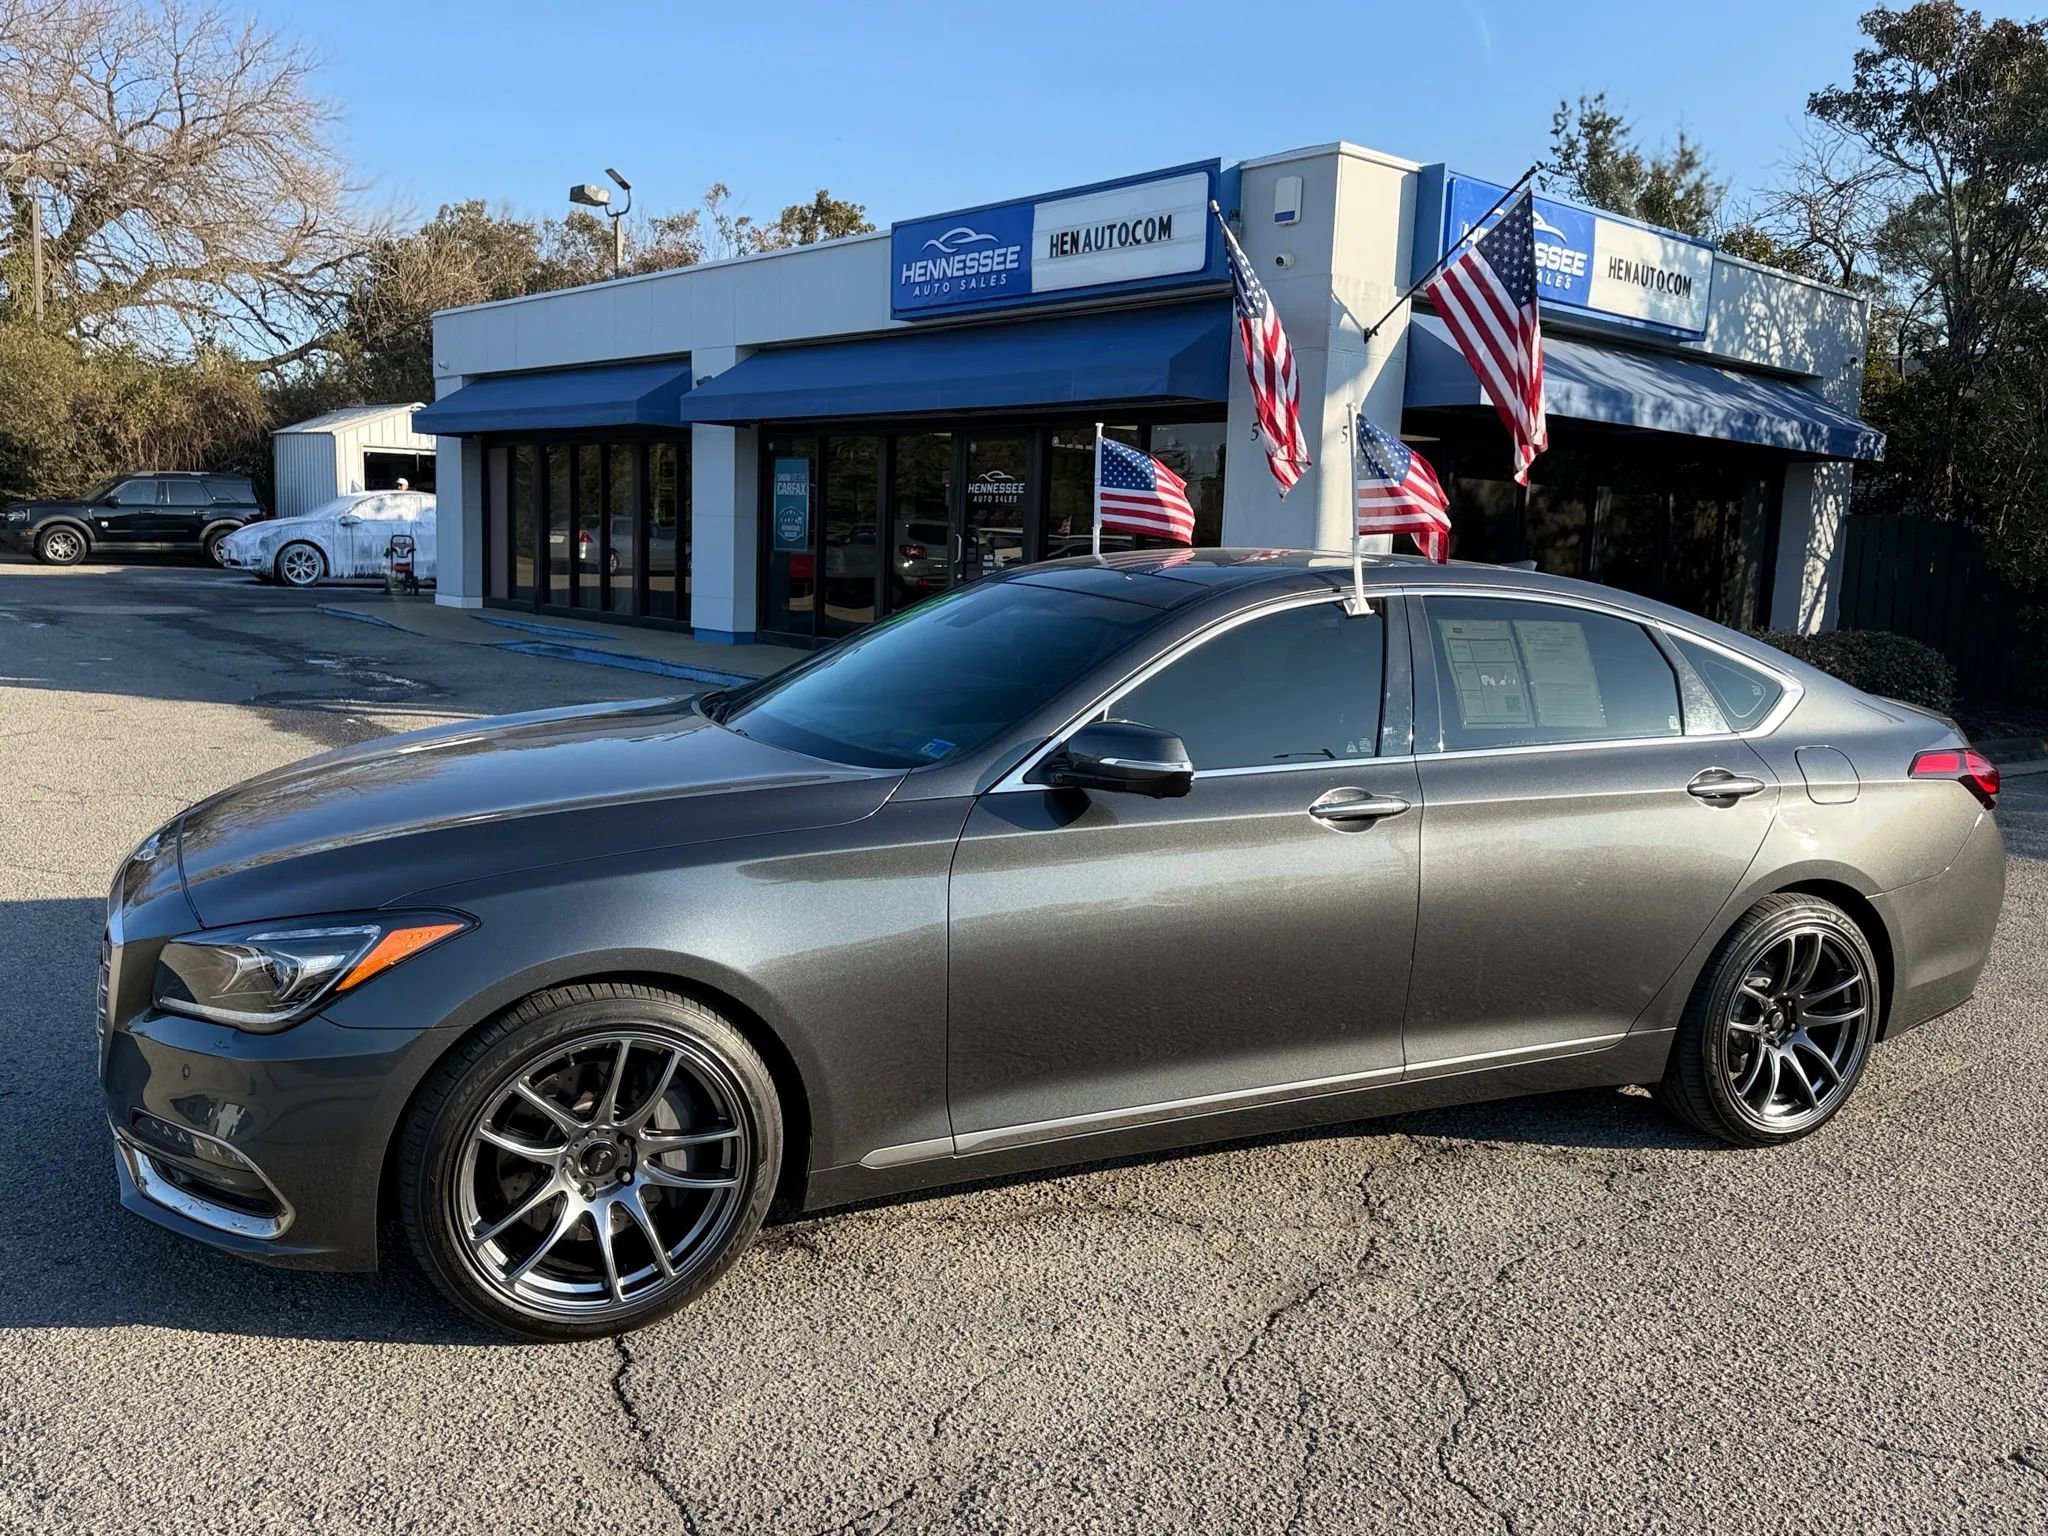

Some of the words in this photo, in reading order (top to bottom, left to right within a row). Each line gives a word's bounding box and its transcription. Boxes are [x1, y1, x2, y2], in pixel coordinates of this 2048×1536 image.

[1048, 214, 1173, 258] HENAUTO.COM
[1460, 221, 1588, 277] HSSEE
[901, 245, 1021, 285] HENNESSEE
[913, 282, 951, 297] AUTO
[960, 273, 1008, 291] SALES
[1536, 268, 1573, 290] ALES
[1608, 256, 1692, 299] HENAUTO.COM
[777, 482, 807, 496] CARFAX
[967, 482, 1026, 494] HENNESSEE
[973, 495, 993, 503] AUTO
[995, 495, 1018, 503] SALES
